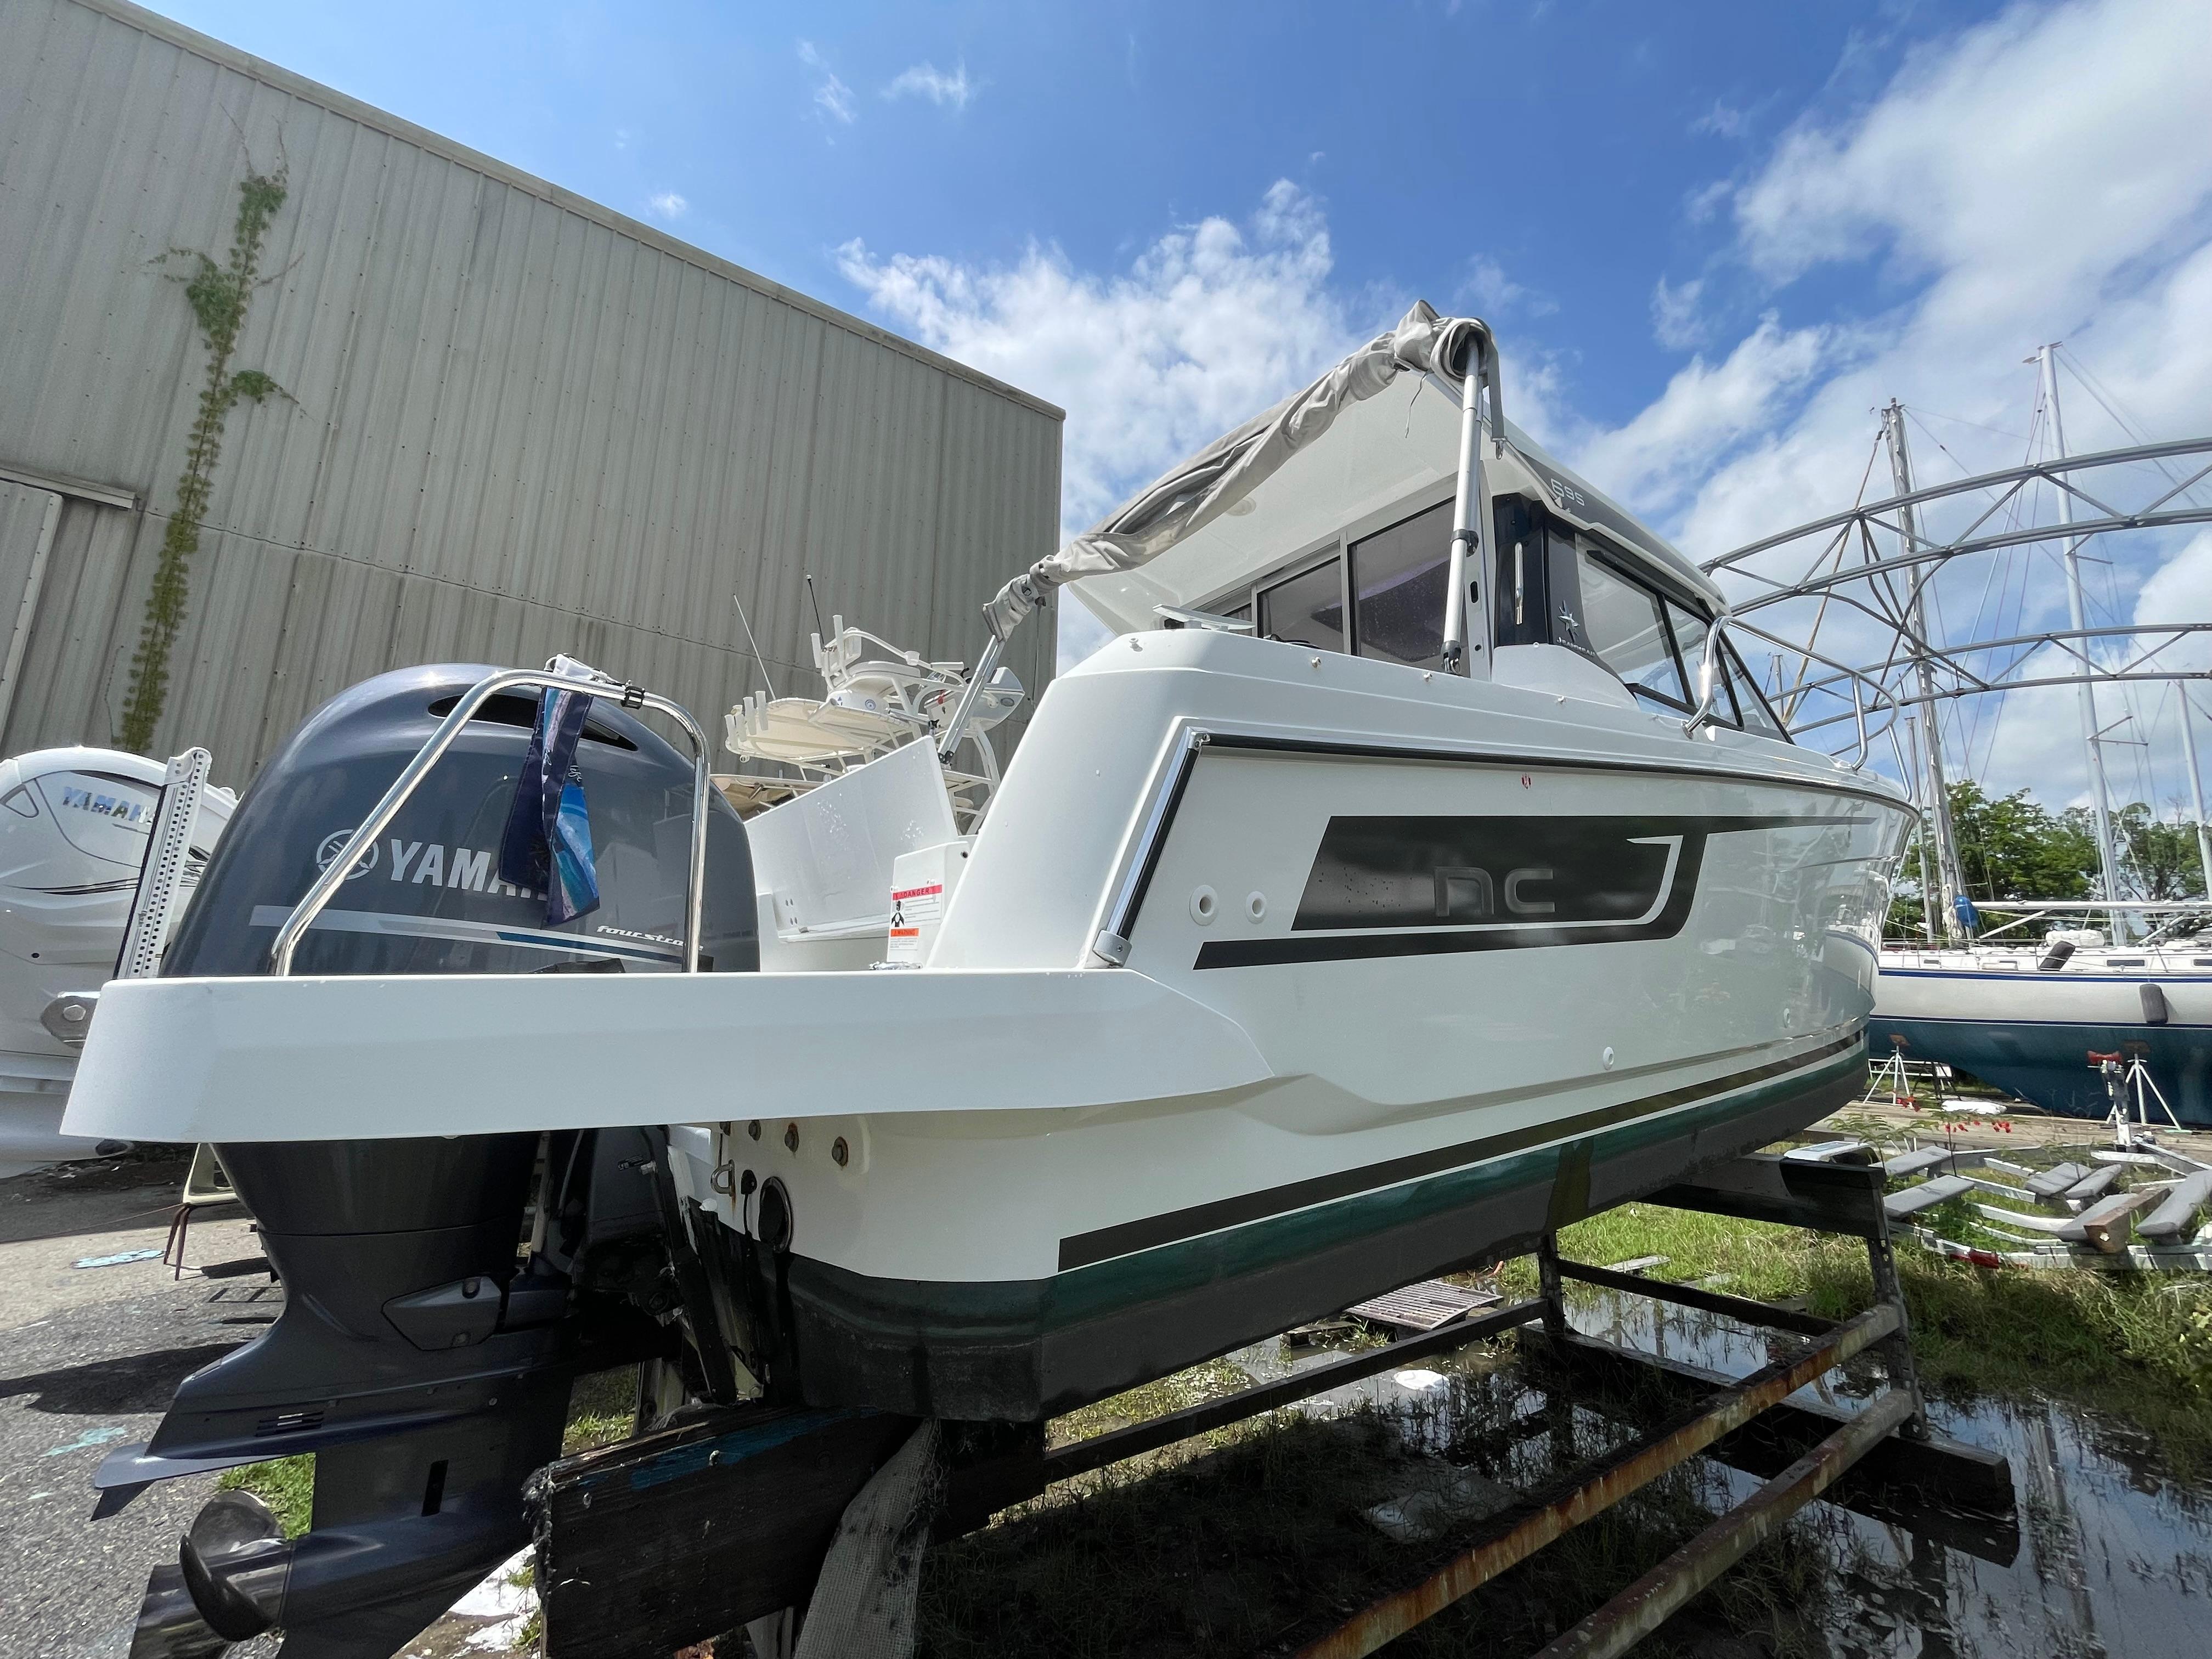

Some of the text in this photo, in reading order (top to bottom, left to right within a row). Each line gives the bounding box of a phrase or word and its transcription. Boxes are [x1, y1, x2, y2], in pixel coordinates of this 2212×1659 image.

[1550, 478, 1585, 506] 695
[391, 838, 548, 901] YAM
[904, 888, 929, 899] DANGER
[596, 925, 703, 951] fourstro
